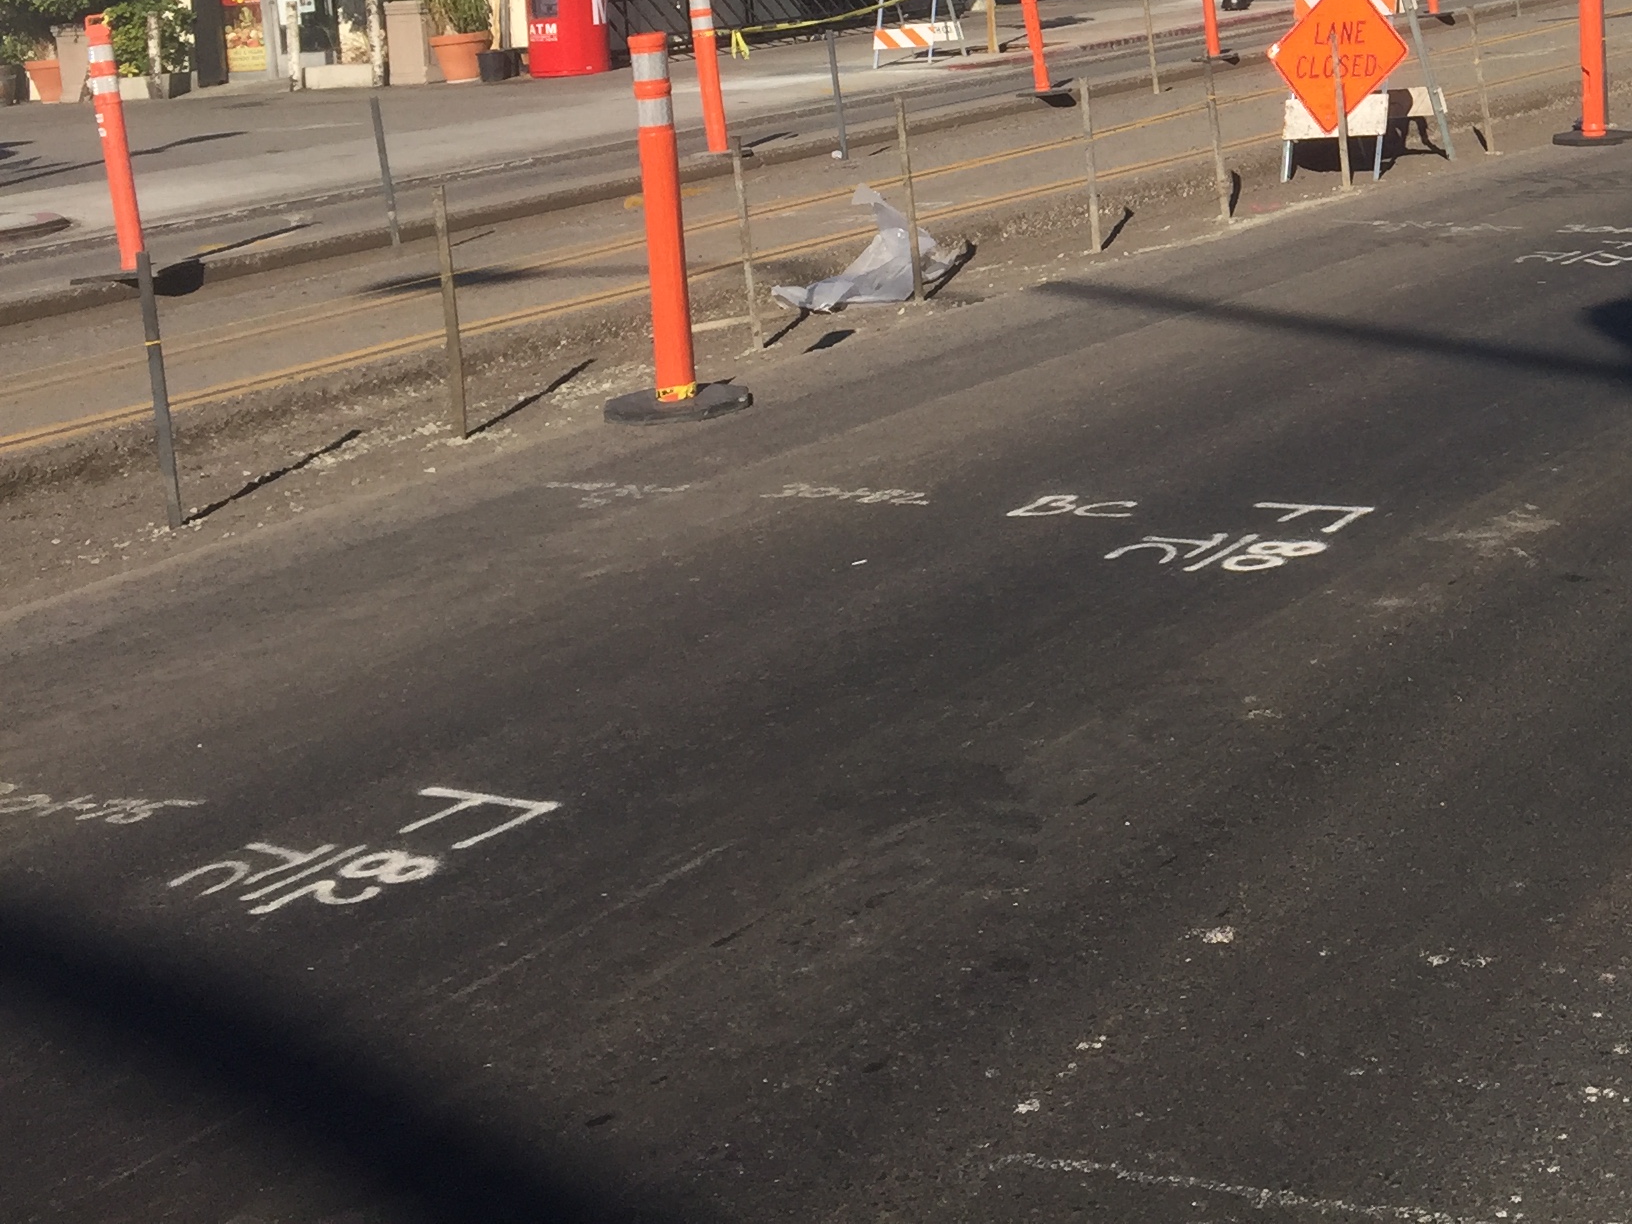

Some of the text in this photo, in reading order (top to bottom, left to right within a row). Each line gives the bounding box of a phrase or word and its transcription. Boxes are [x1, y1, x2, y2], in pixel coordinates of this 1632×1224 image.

[529, 23, 557, 35] ATM
[1314, 21, 1367, 46] LANE
[1296, 54, 1378, 80] CLOSED
[1005, 494, 1139, 518] BC
